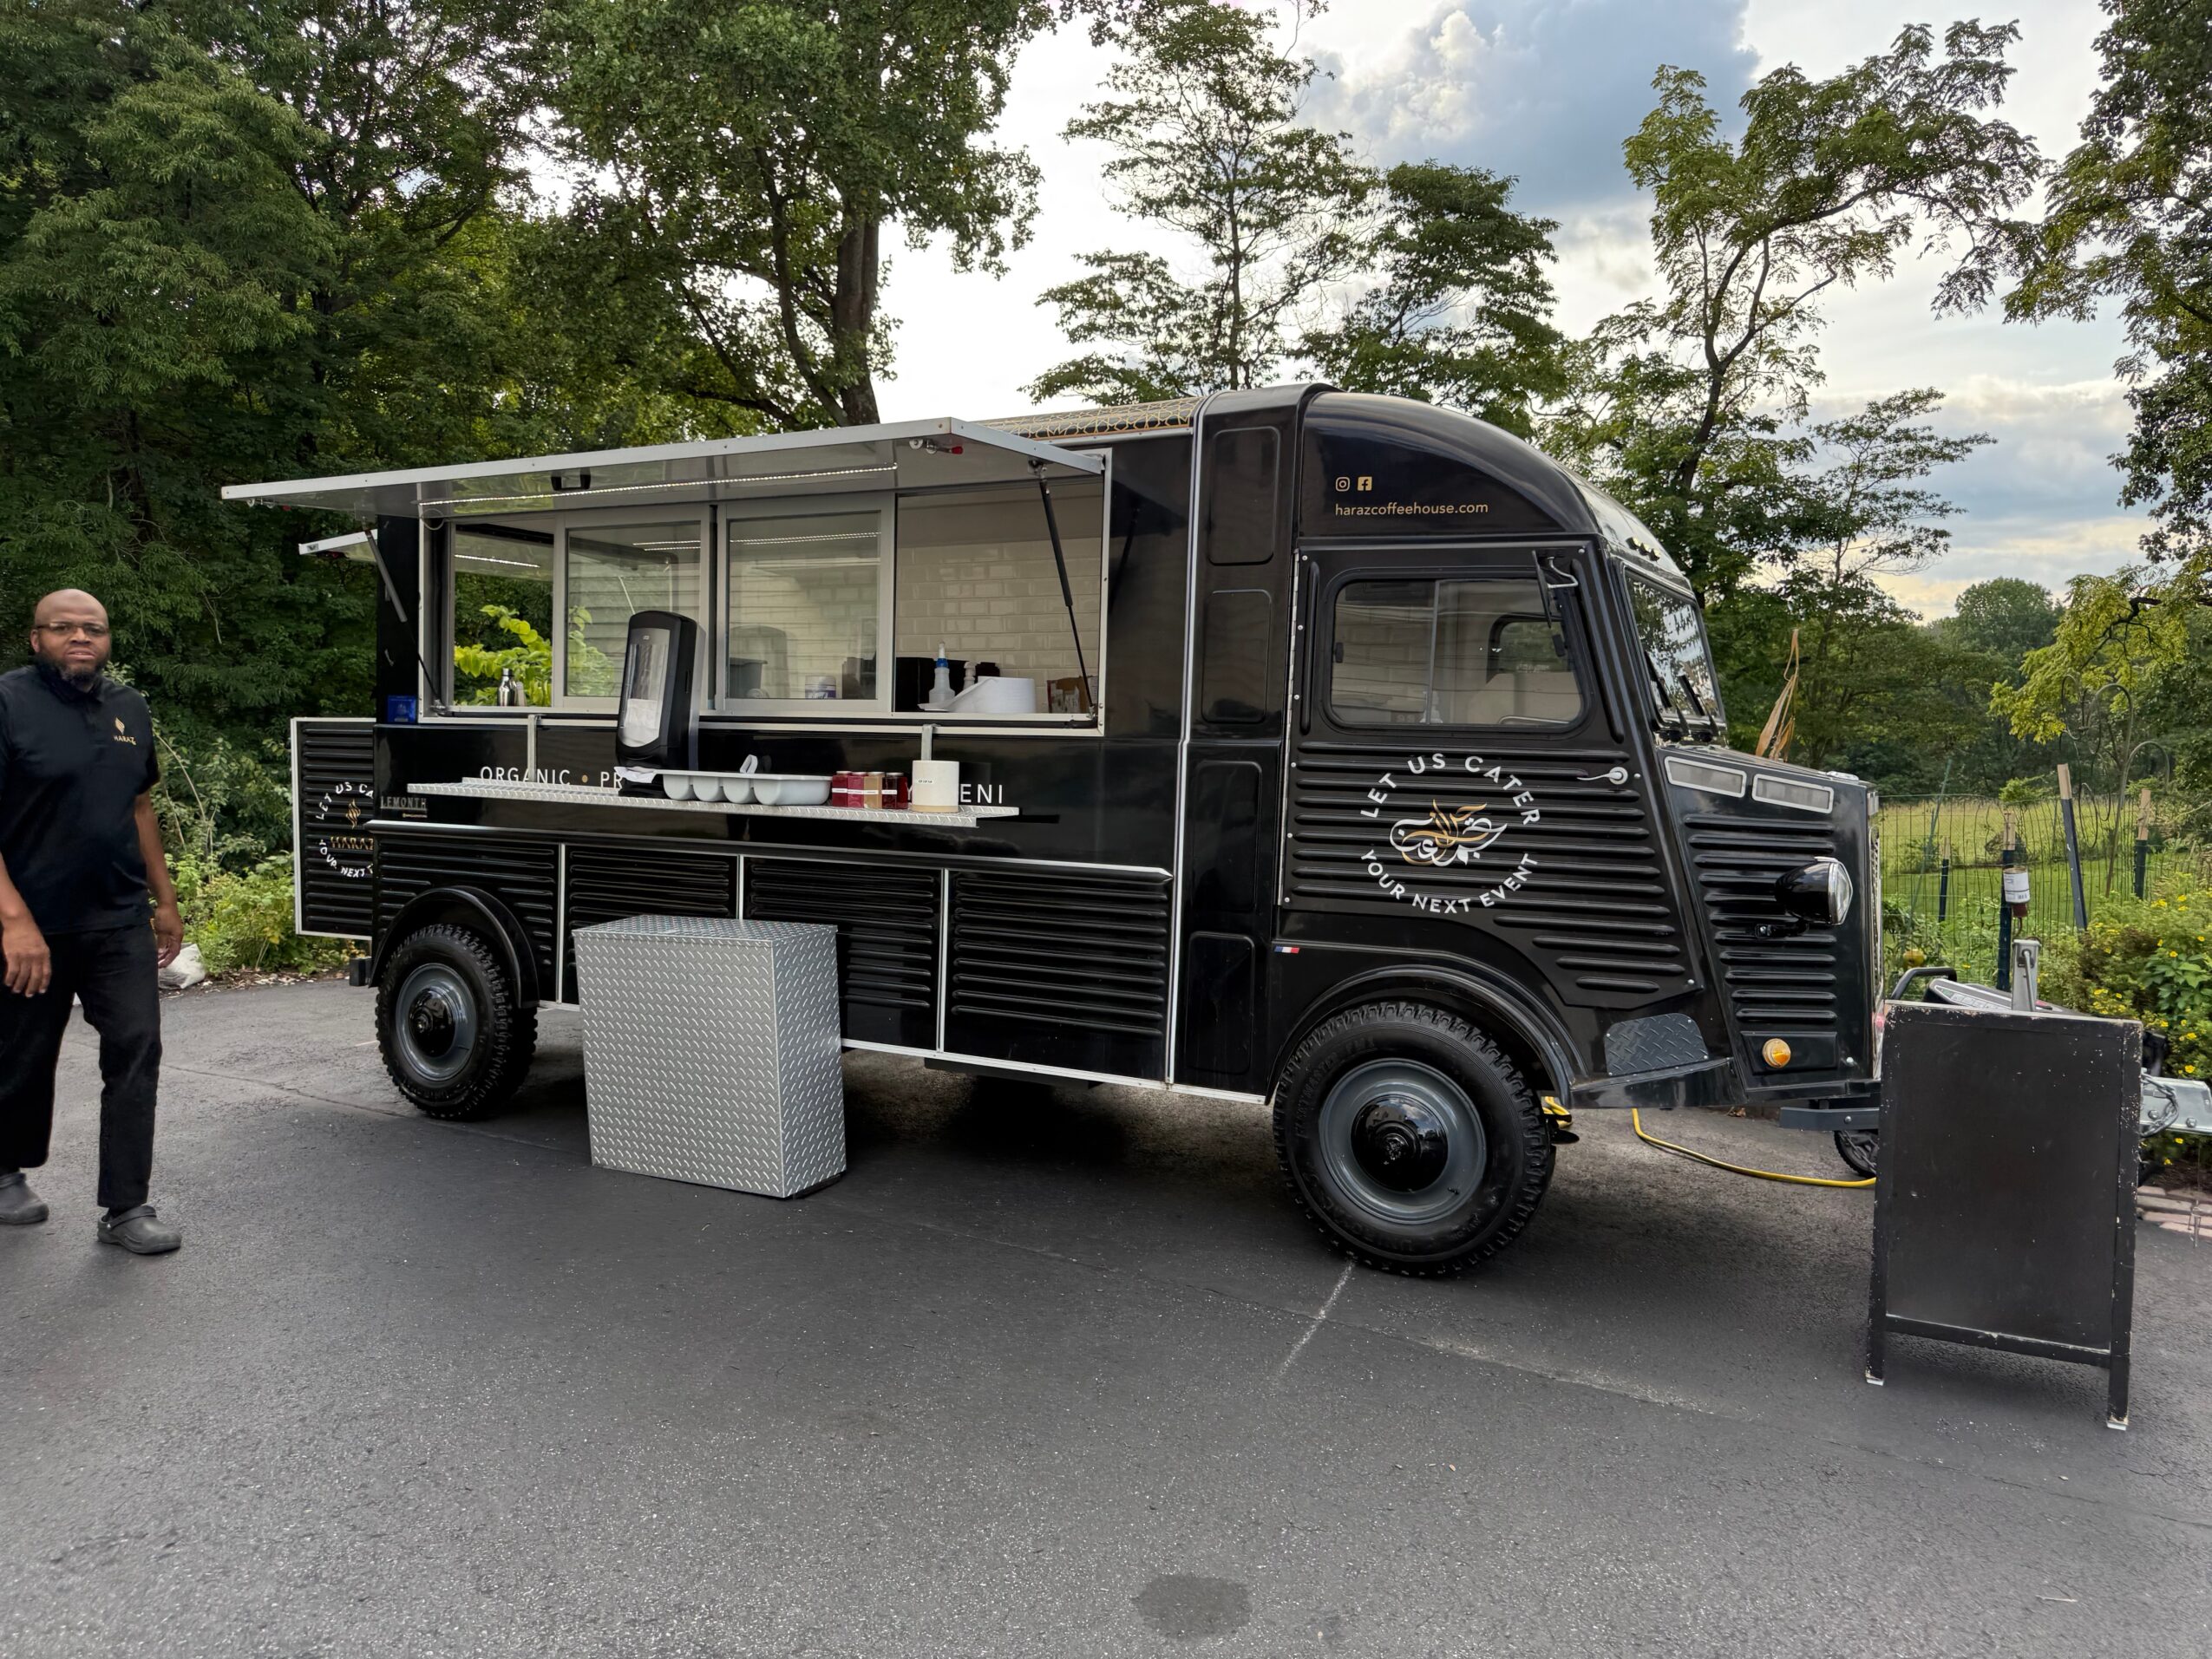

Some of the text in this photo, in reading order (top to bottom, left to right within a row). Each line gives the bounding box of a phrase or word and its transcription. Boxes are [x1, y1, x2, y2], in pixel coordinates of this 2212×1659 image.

[1335, 501, 1489, 516] harazcoffeehouse.com
[316, 793, 332, 820] LET
[335, 781, 352, 794] US
[1360, 753, 1541, 825] LET US CATER
[319, 839, 337, 869] YOUR
[341, 866, 365, 878] NEXT
[1361, 849, 1538, 913] YOUR NEXT EVENT
